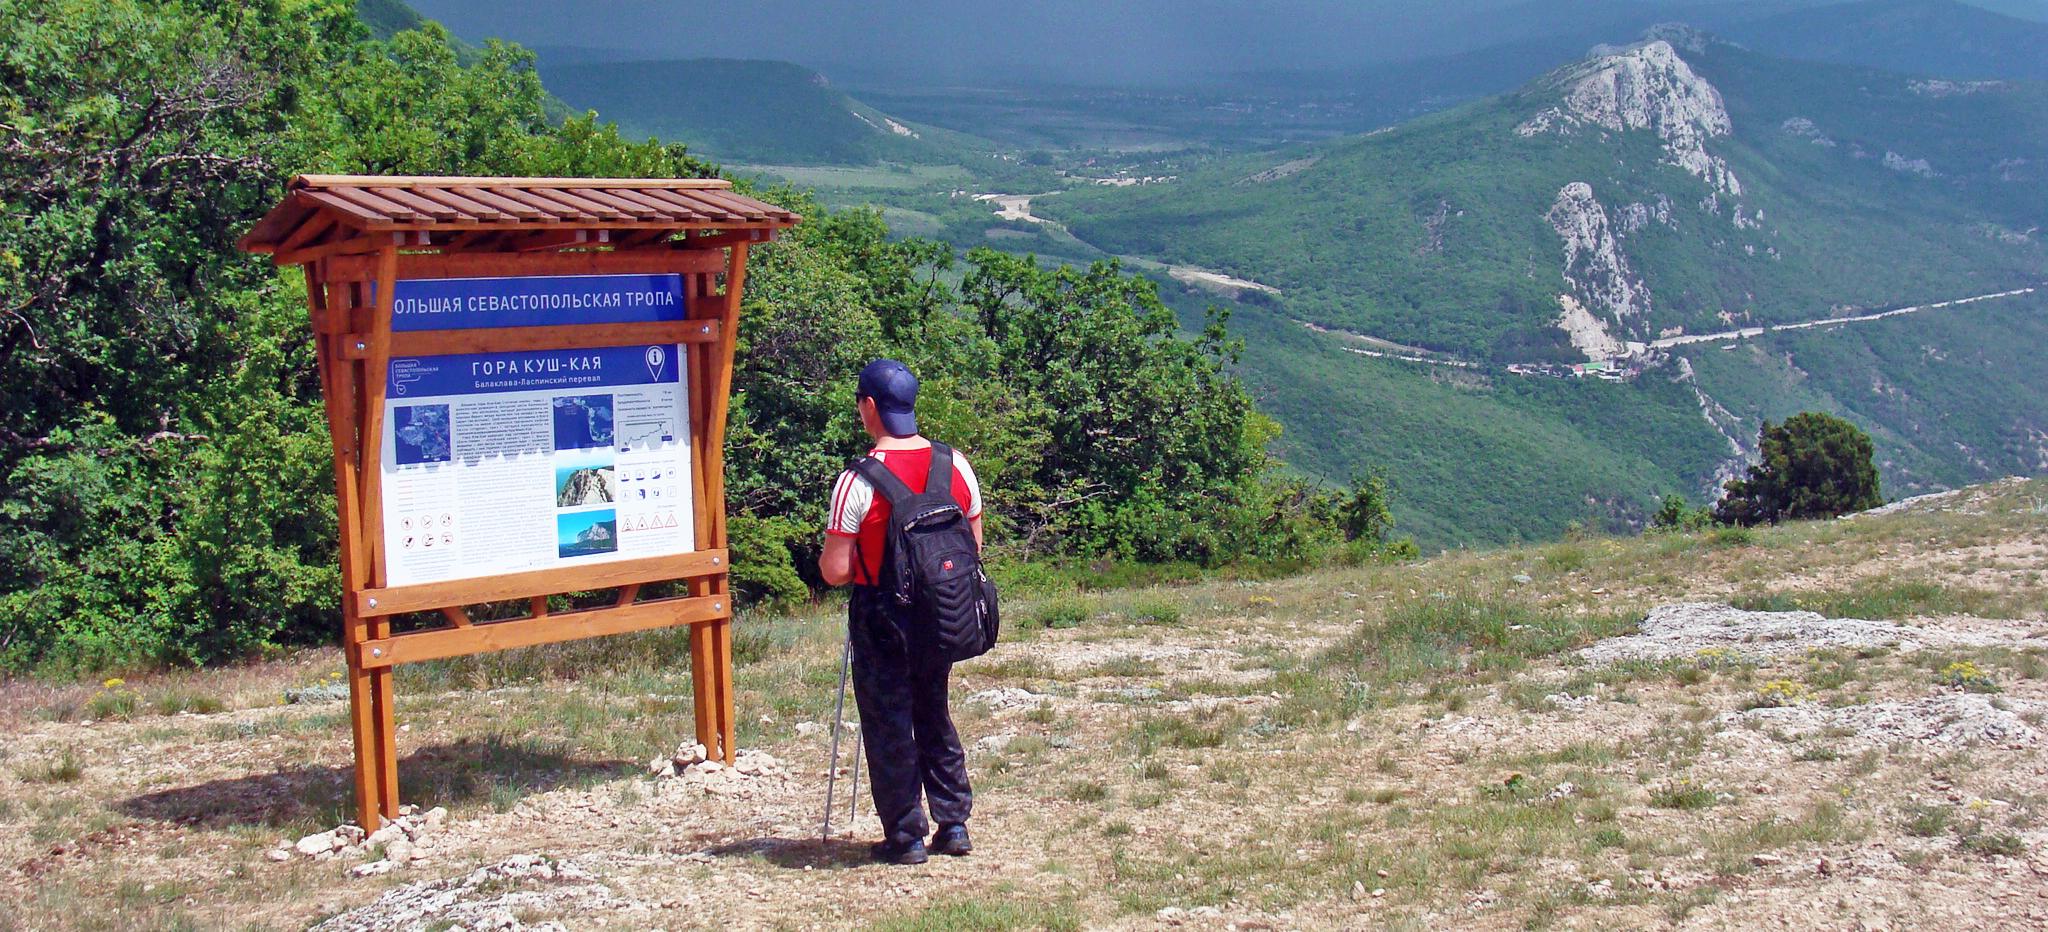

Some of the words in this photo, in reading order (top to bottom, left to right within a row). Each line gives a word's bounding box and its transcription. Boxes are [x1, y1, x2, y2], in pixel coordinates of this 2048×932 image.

[394, 296, 462, 314] ОЛЬШАЯ
[468, 292, 621, 312] СЕВАСТОПОЛЬСКАЯ
[625, 290, 674, 306] ТРОПА
[472, 360, 518, 376] ГОРА
[524, 356, 602, 373] КУШ-КАЯ
[475, 376, 567, 389] Балаклава-Ласпинский
[569, 375, 601, 384] перевал
